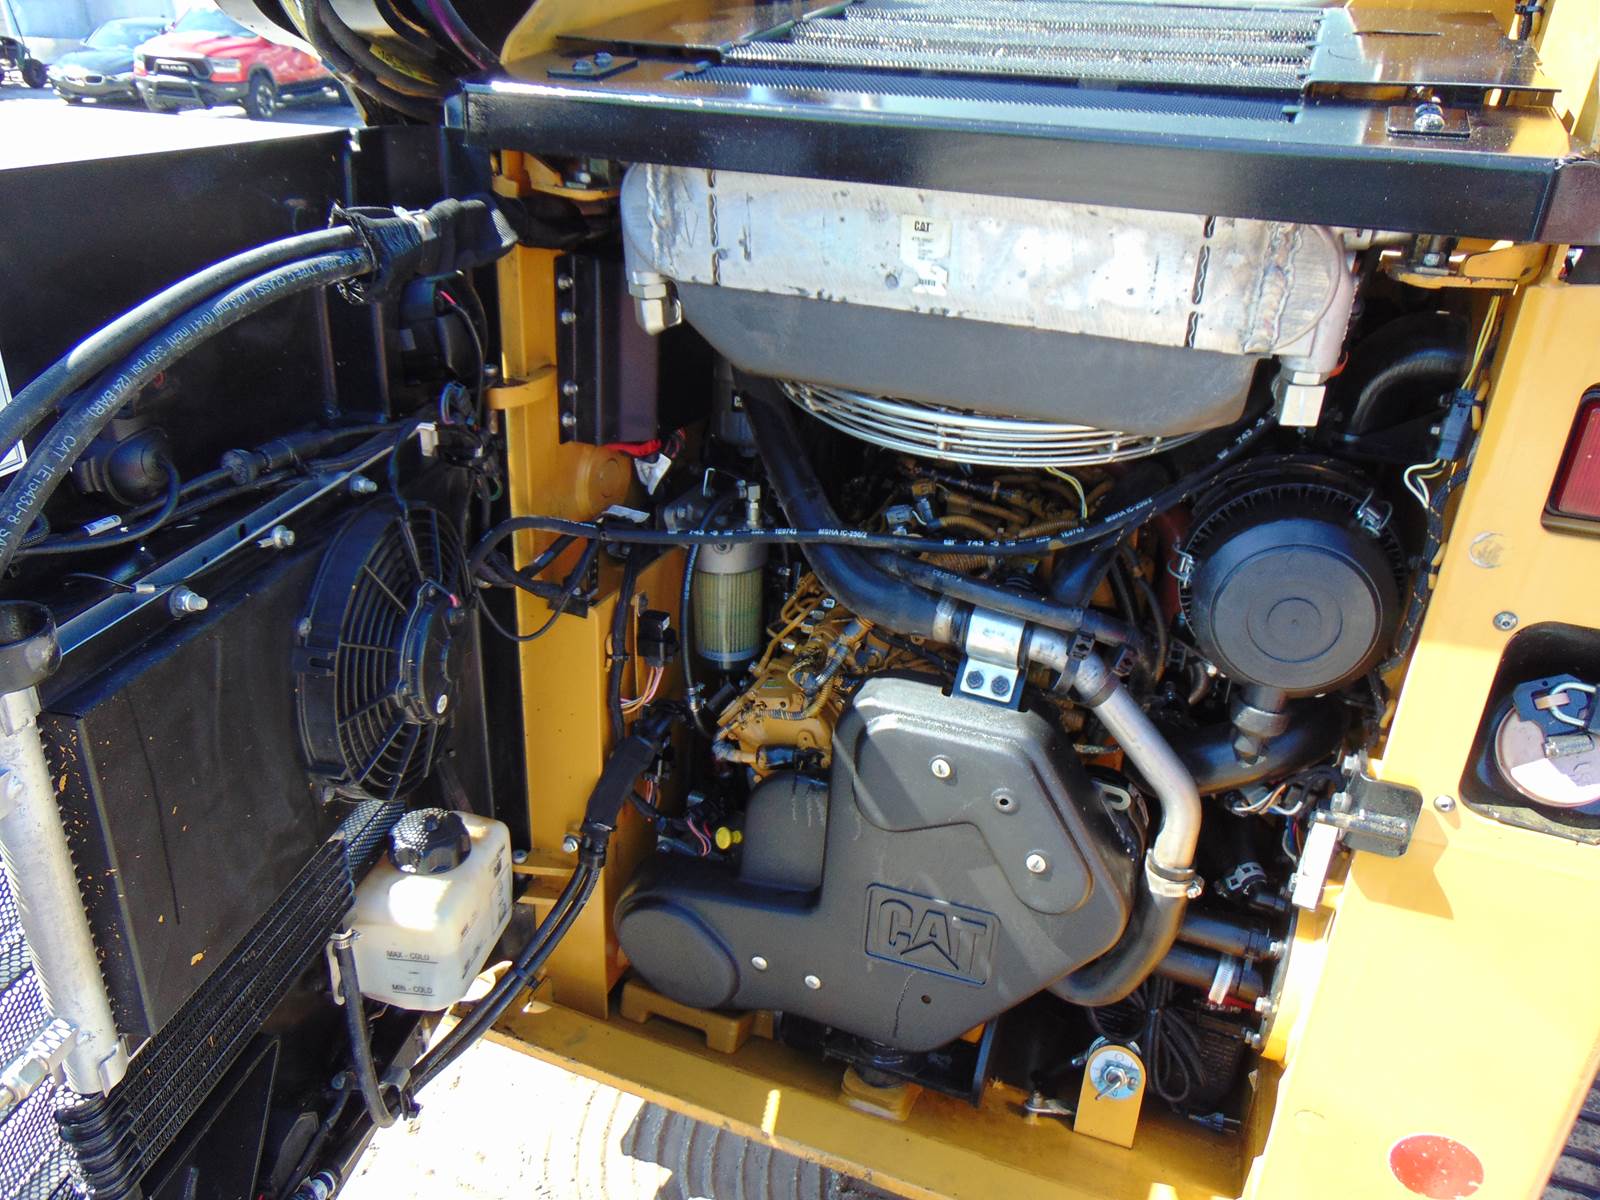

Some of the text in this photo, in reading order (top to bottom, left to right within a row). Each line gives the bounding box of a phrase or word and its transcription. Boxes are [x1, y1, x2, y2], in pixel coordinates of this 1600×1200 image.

[914, 220, 934, 233] CAT
[259, 277, 287, 297] CLASS
[211, 301, 231, 318] mm
[165, 326, 193, 349] inch)
[130, 358, 148, 376] psi
[86, 390, 117, 417] BAR)
[53, 435, 77, 462] CAT
[878, 898, 988, 976] CAT
[386, 950, 404, 960] MAX
[409, 952, 431, 961] COLD
[392, 983, 408, 993] MIN
[412, 985, 433, 994] COLD
